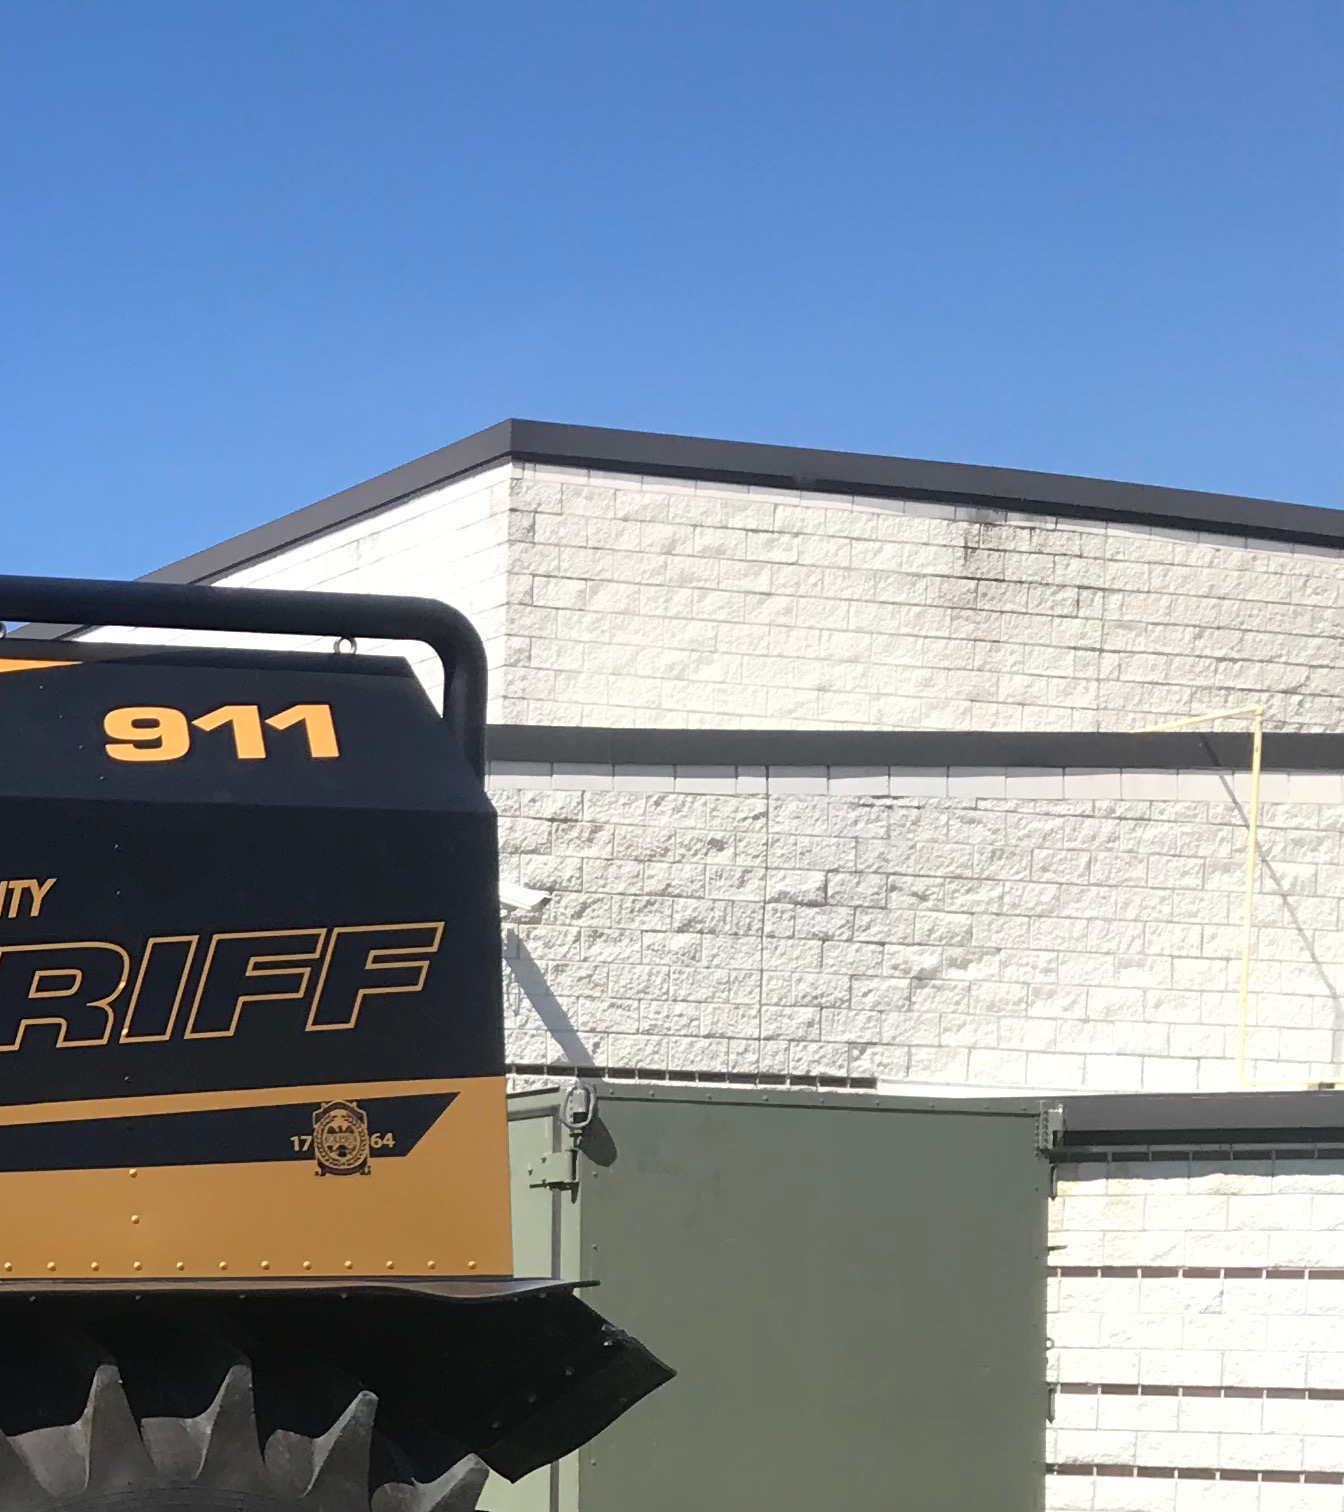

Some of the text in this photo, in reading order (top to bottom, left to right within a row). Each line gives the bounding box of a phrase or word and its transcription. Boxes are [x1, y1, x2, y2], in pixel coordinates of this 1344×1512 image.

[103, 703, 340, 762] 911
[290, 1135, 313, 1152] 17
[370, 1132, 395, 1148] 64
